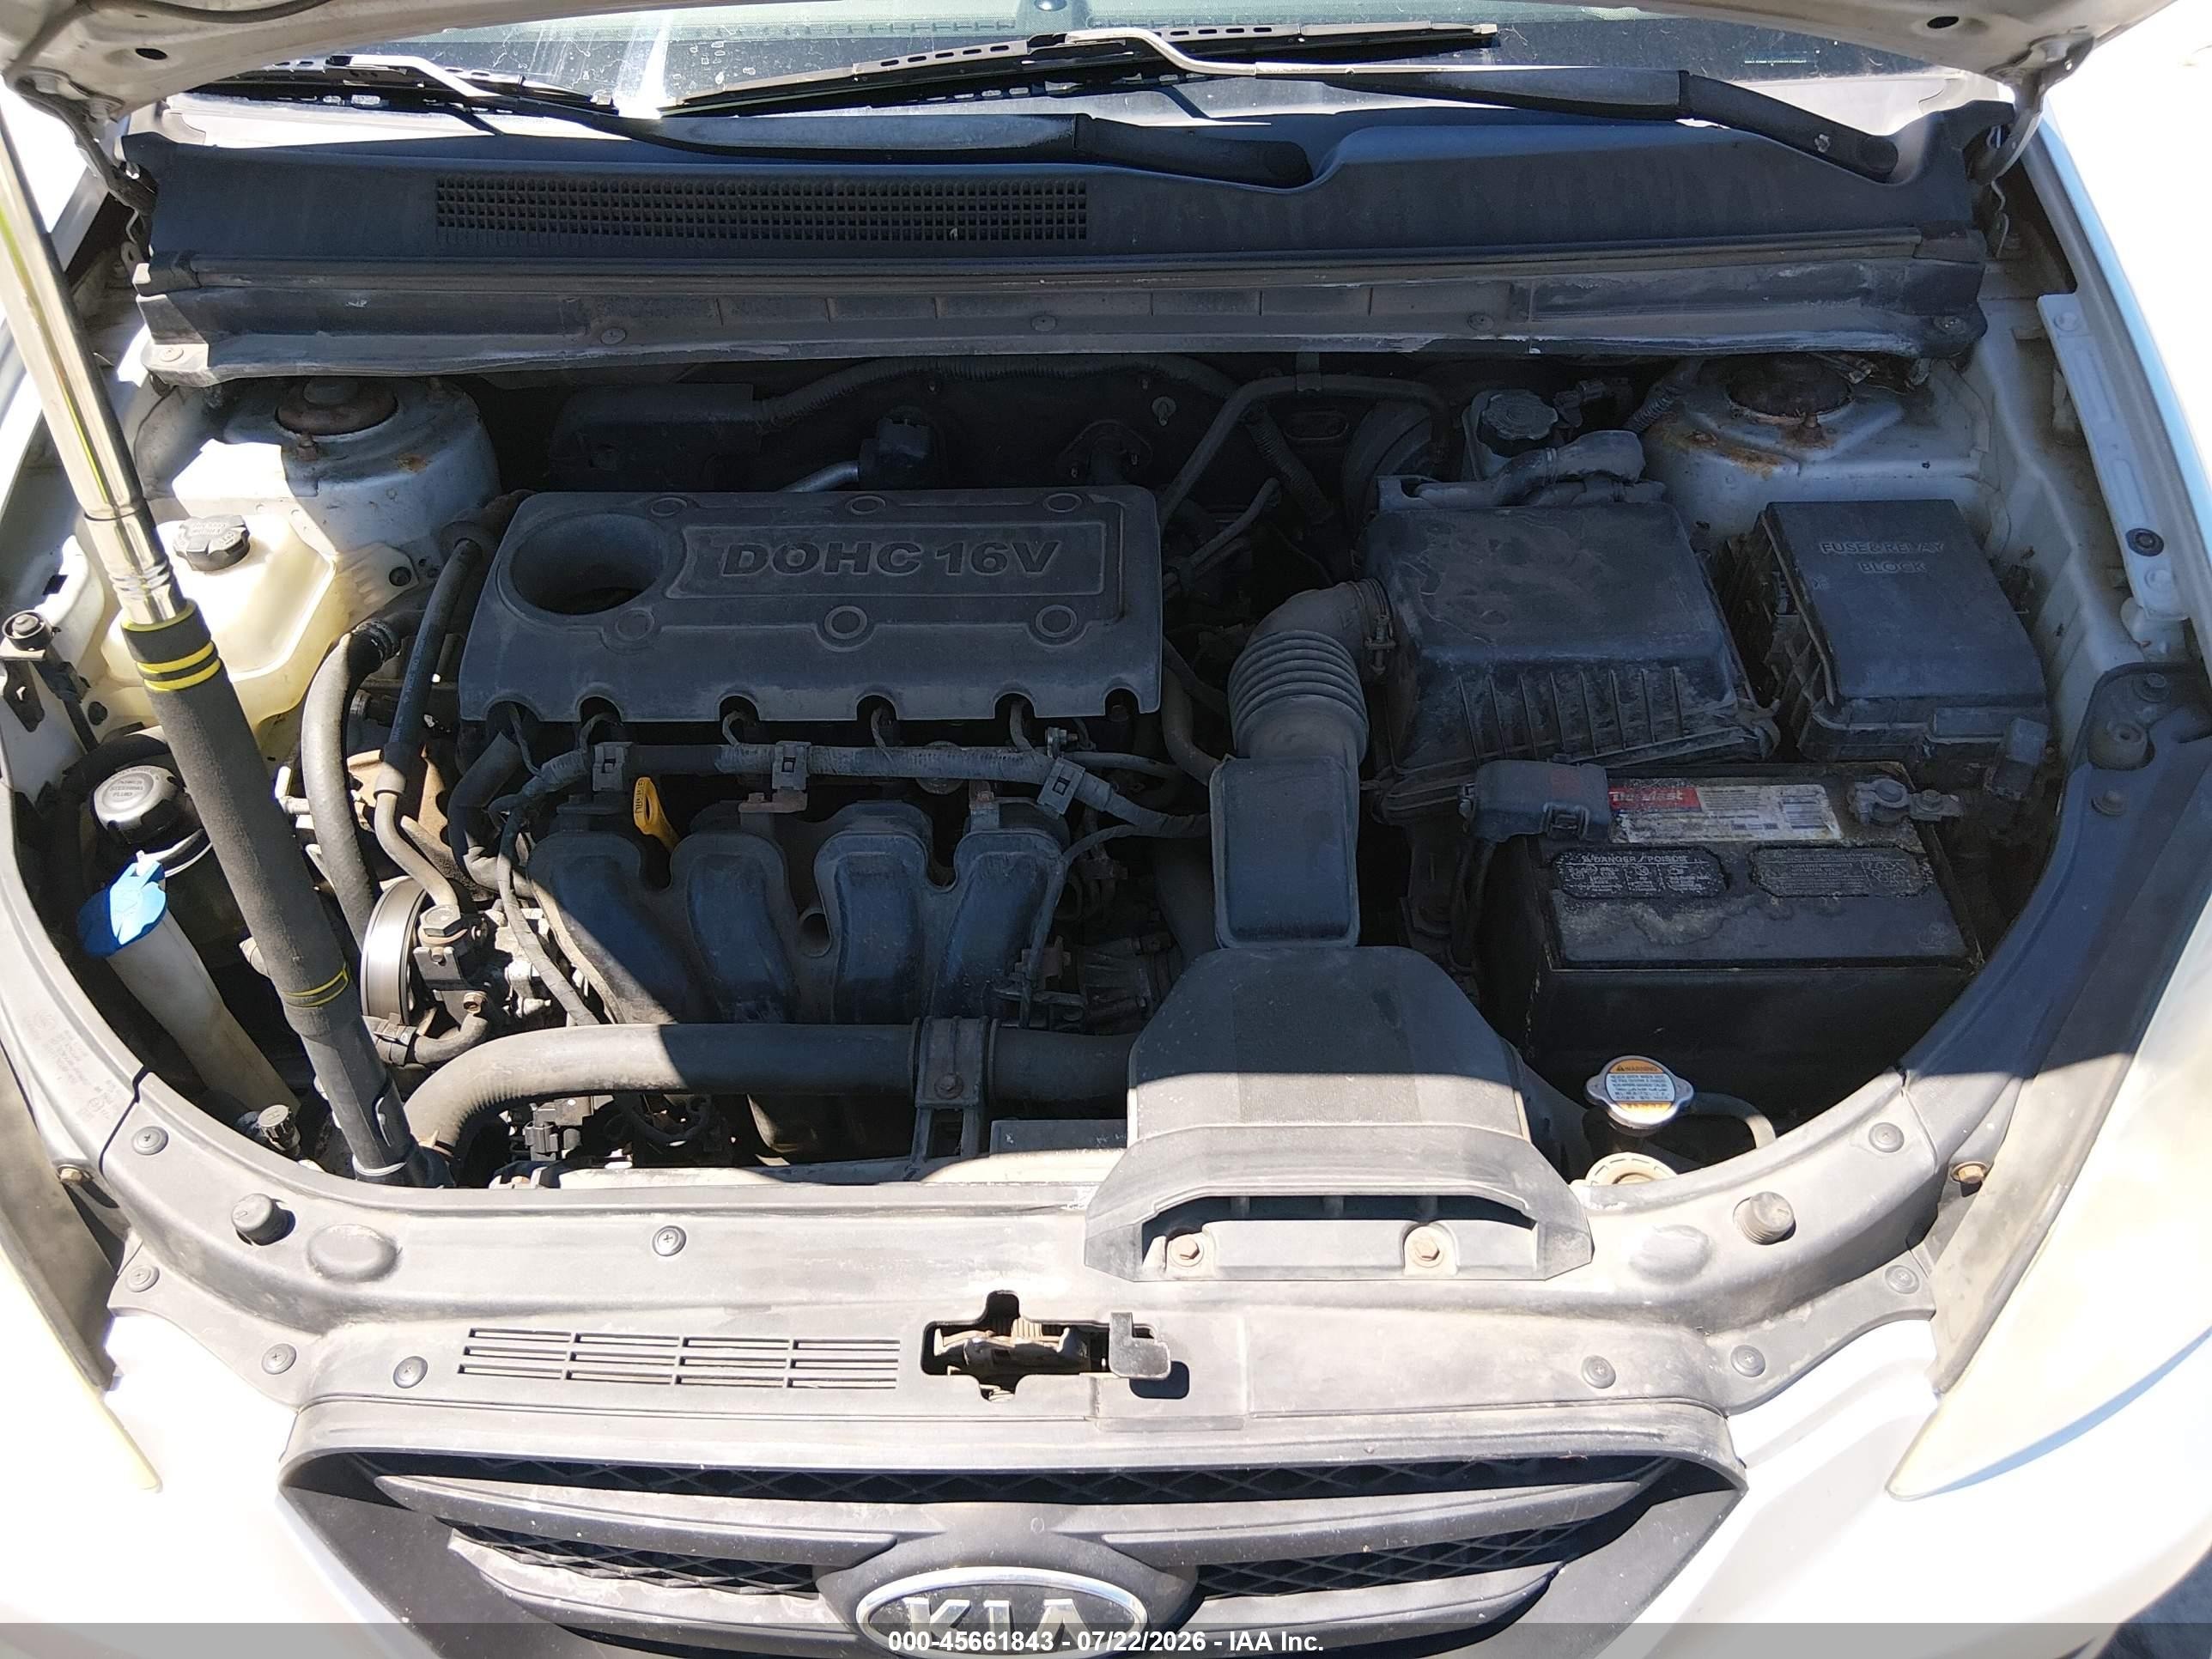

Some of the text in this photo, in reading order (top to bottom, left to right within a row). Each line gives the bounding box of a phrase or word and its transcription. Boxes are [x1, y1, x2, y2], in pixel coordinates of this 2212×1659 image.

[721, 541, 1061, 577] DOHC 16V
[1857, 561, 1926, 573] BLOCK
[902, 1597, 1097, 1651] KIA
